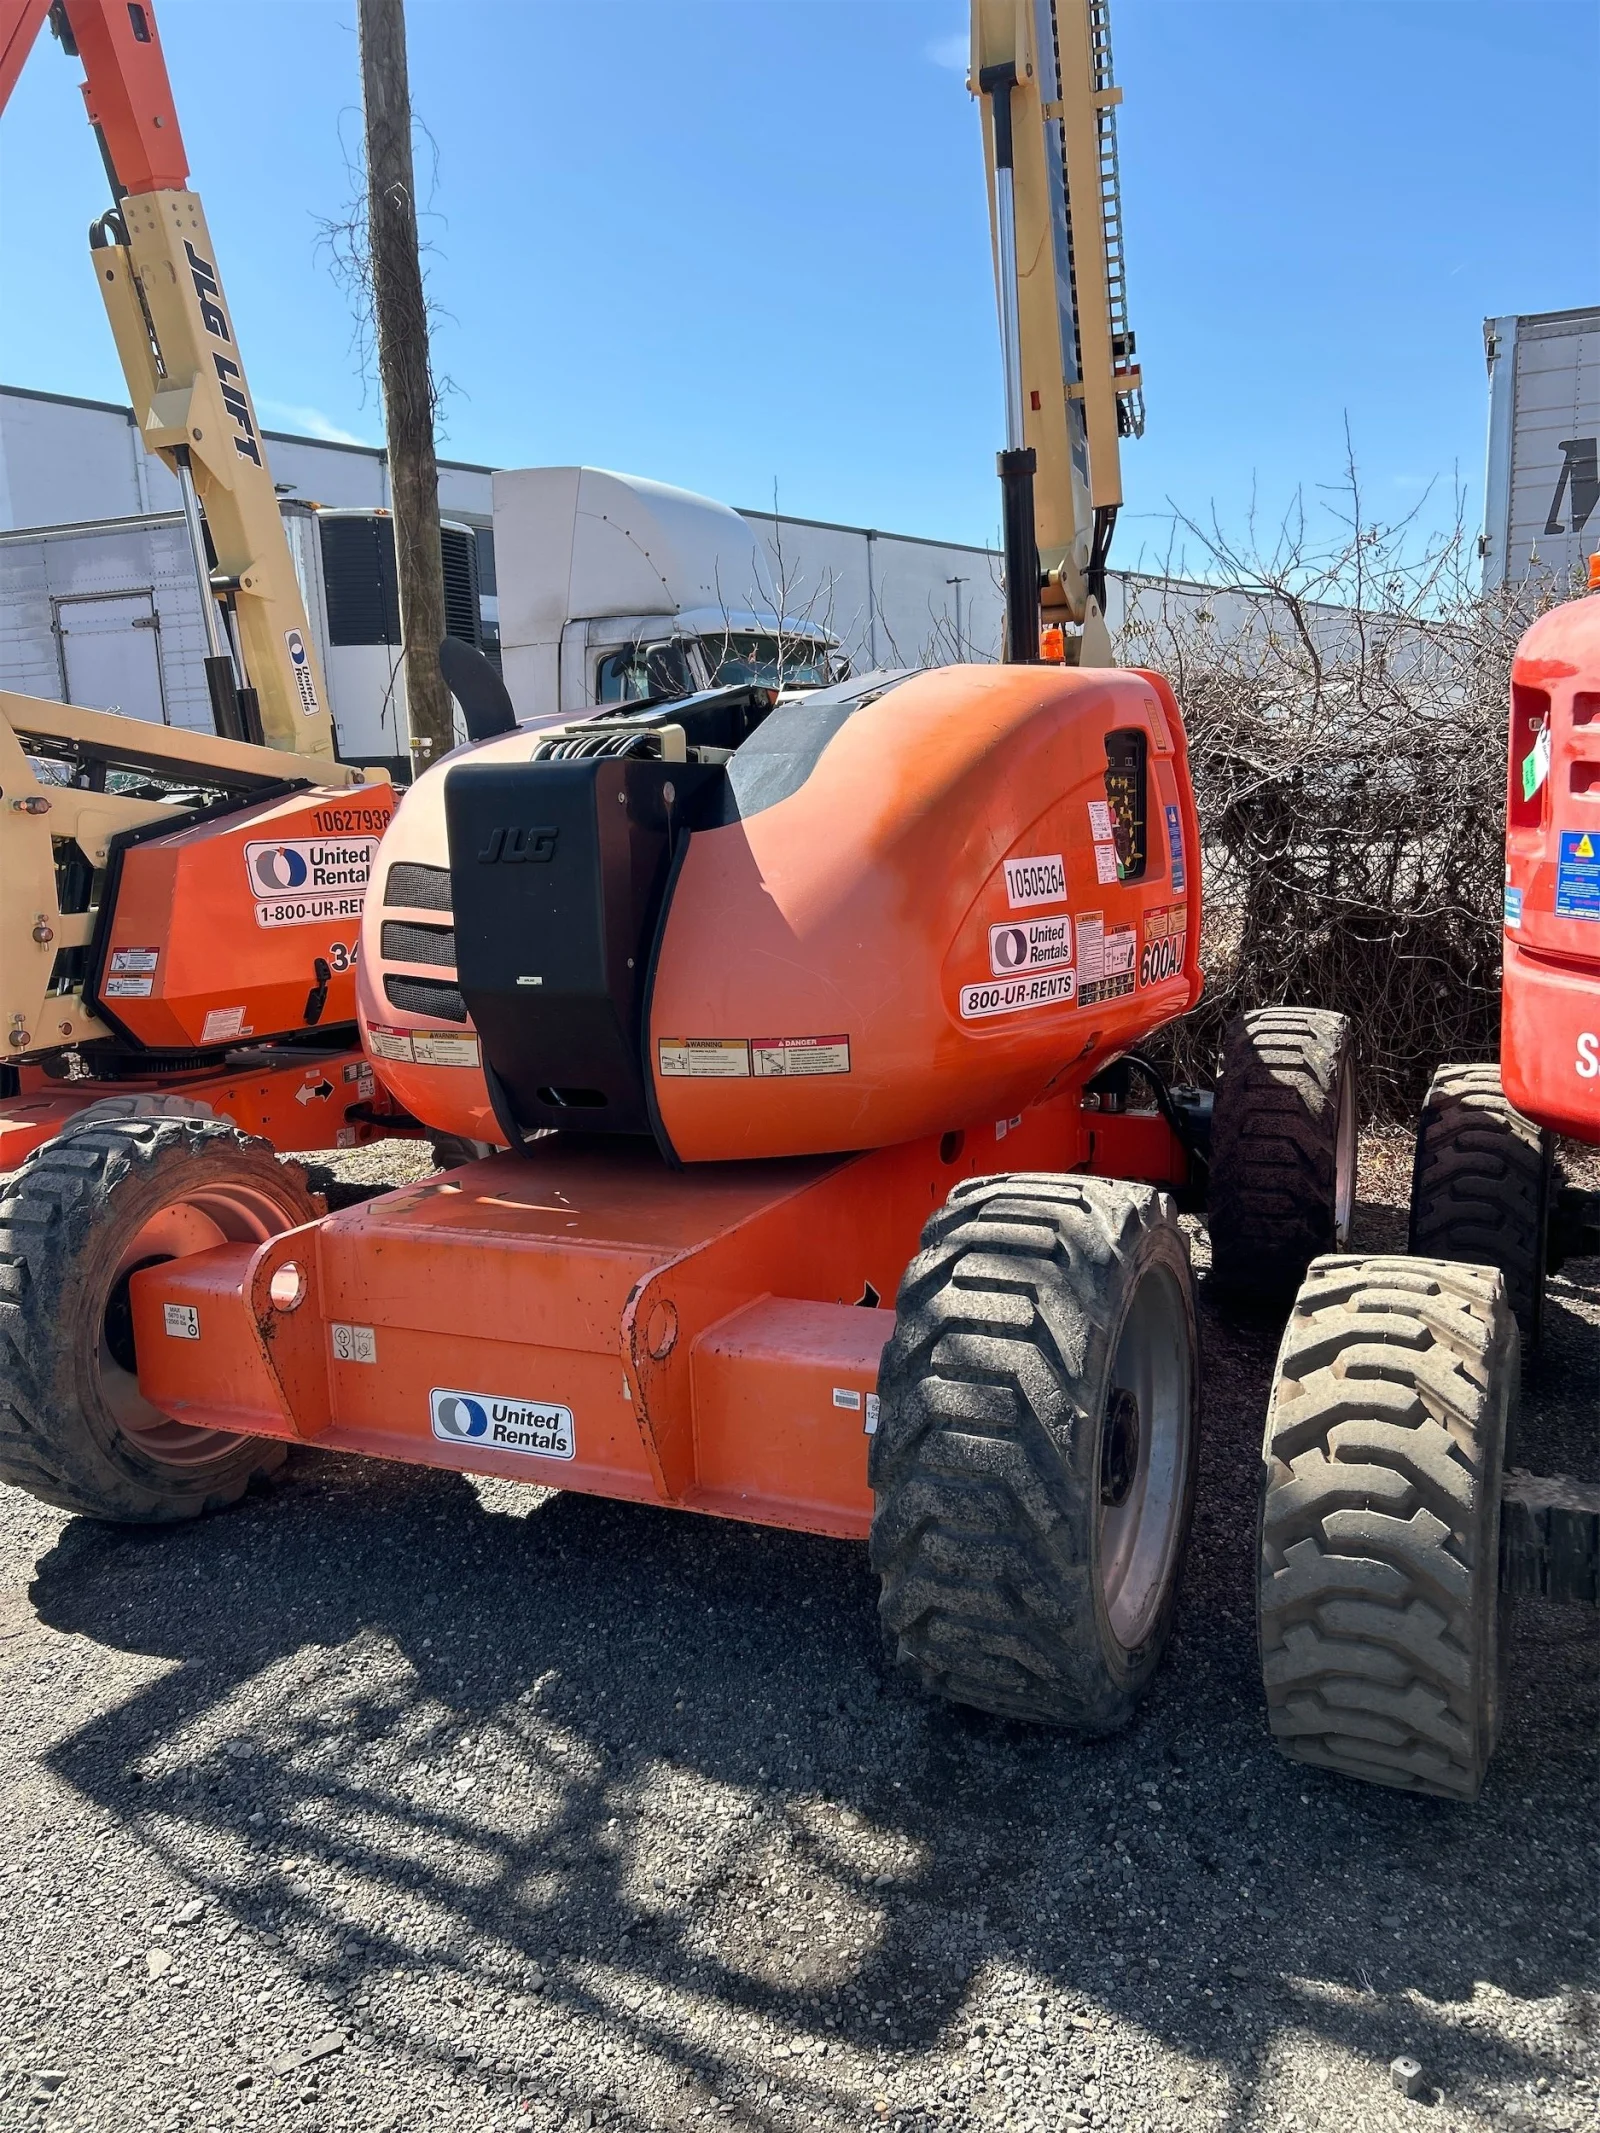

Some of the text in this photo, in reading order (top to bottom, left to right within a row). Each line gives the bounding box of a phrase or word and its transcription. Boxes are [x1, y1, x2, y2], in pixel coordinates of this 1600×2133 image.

[184, 237, 263, 470] JLG LIFT
[1543, 437, 1600, 535] M
[294, 667, 310, 712] Rentals
[302, 665, 317, 706] United
[313, 808, 391, 833] 10627938
[310, 845, 370, 866] United
[477, 825, 559, 865] JLG
[313, 865, 370, 886] Rental
[1007, 863, 1065, 900] 10505264
[1029, 922, 1066, 946] United
[1030, 943, 1069, 964] Rentals
[1139, 933, 1187, 989] 600AJ
[968, 974, 1072, 1011] 800-UR-RENTS
[433, 1032, 459, 1040] WARNING
[785, 1039, 817, 1047] DANGER
[1575, 1031, 1600, 1079] S
[492, 1404, 560, 1430] United
[492, 1424, 568, 1451] Rentals
